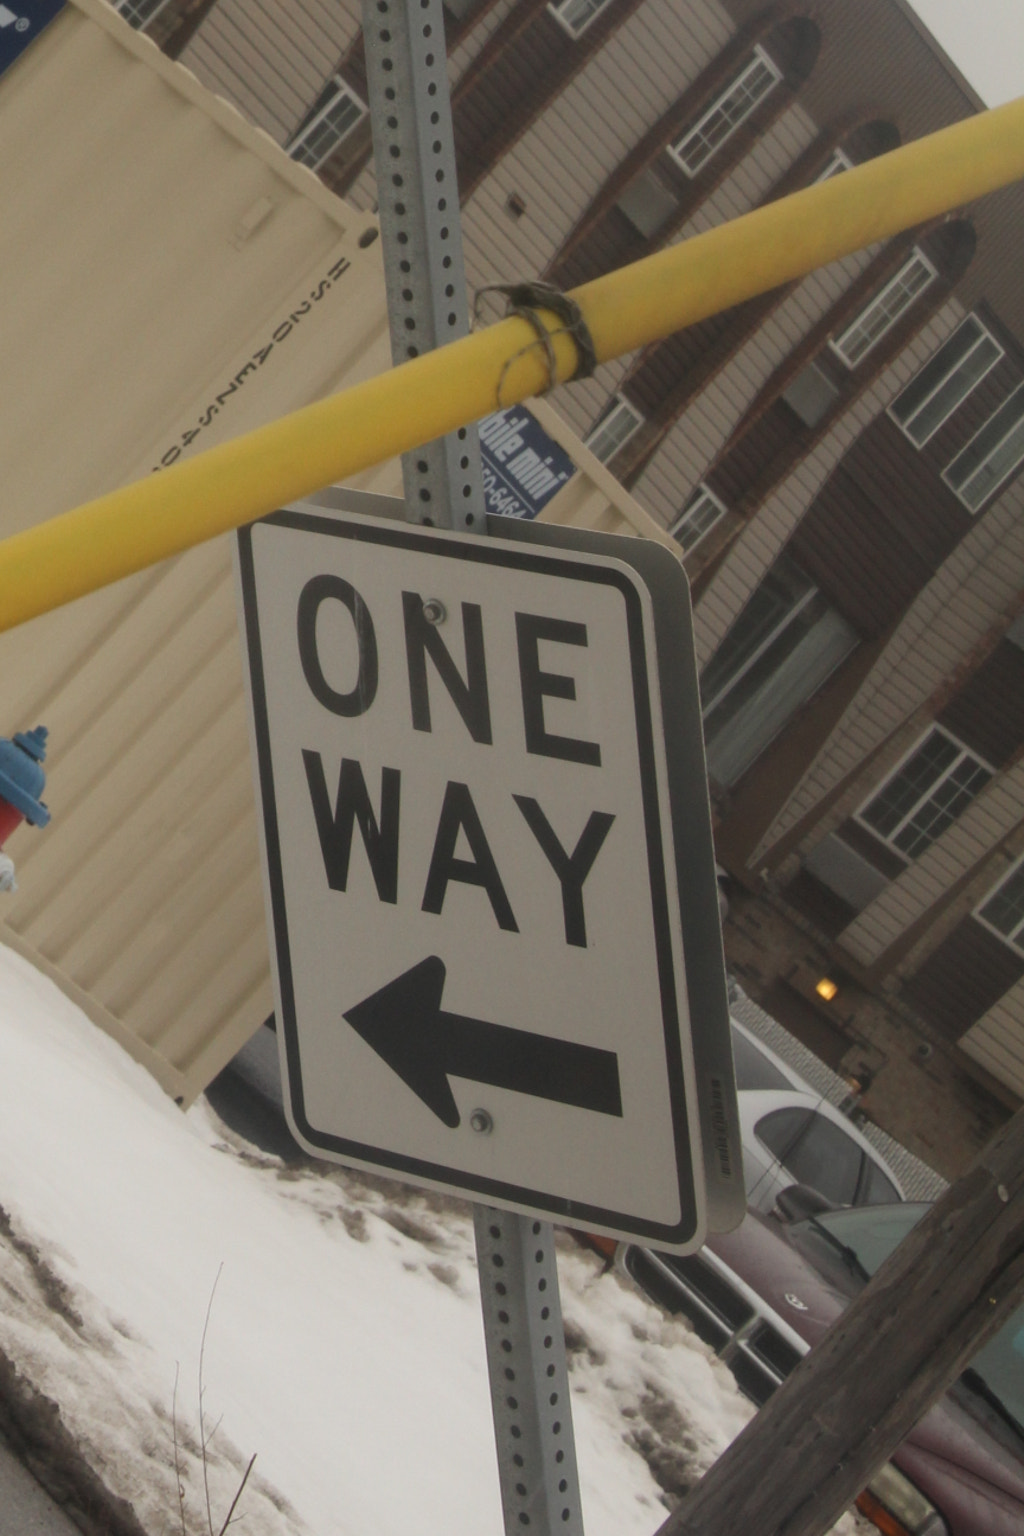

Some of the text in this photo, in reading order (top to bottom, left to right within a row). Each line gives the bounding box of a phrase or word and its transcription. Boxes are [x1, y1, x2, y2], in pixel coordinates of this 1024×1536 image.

[152, 257, 351, 472] HS20AEZS40
[479, 406, 568, 500] bile mini
[297, 574, 602, 767] ONE
[301, 749, 616, 948] WAY
